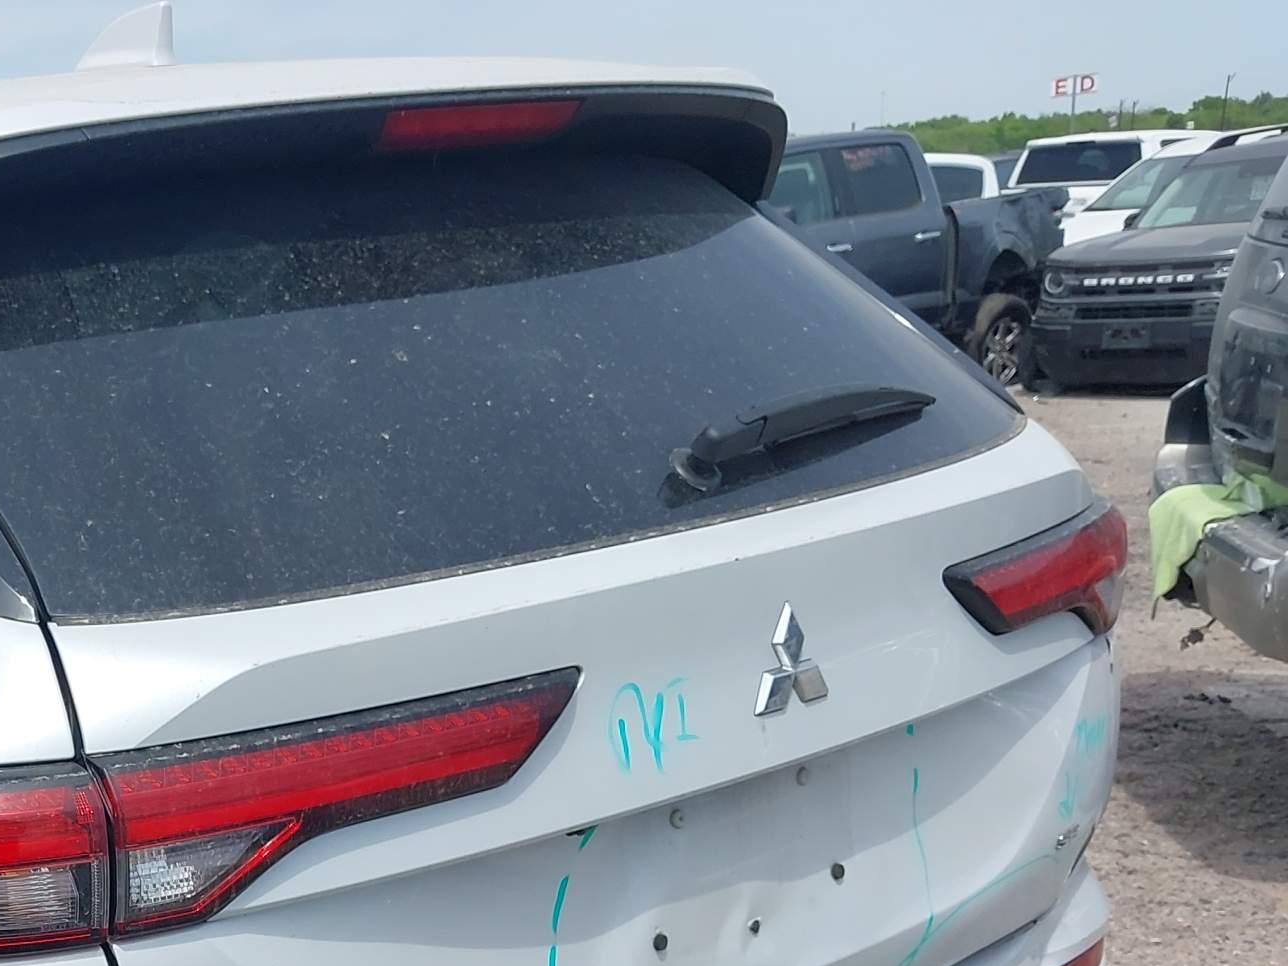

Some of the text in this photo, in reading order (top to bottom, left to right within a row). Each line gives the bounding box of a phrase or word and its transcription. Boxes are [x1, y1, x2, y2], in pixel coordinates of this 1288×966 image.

[1055, 75, 1095, 95] E D
[1083, 273, 1195, 288] BRONCO
